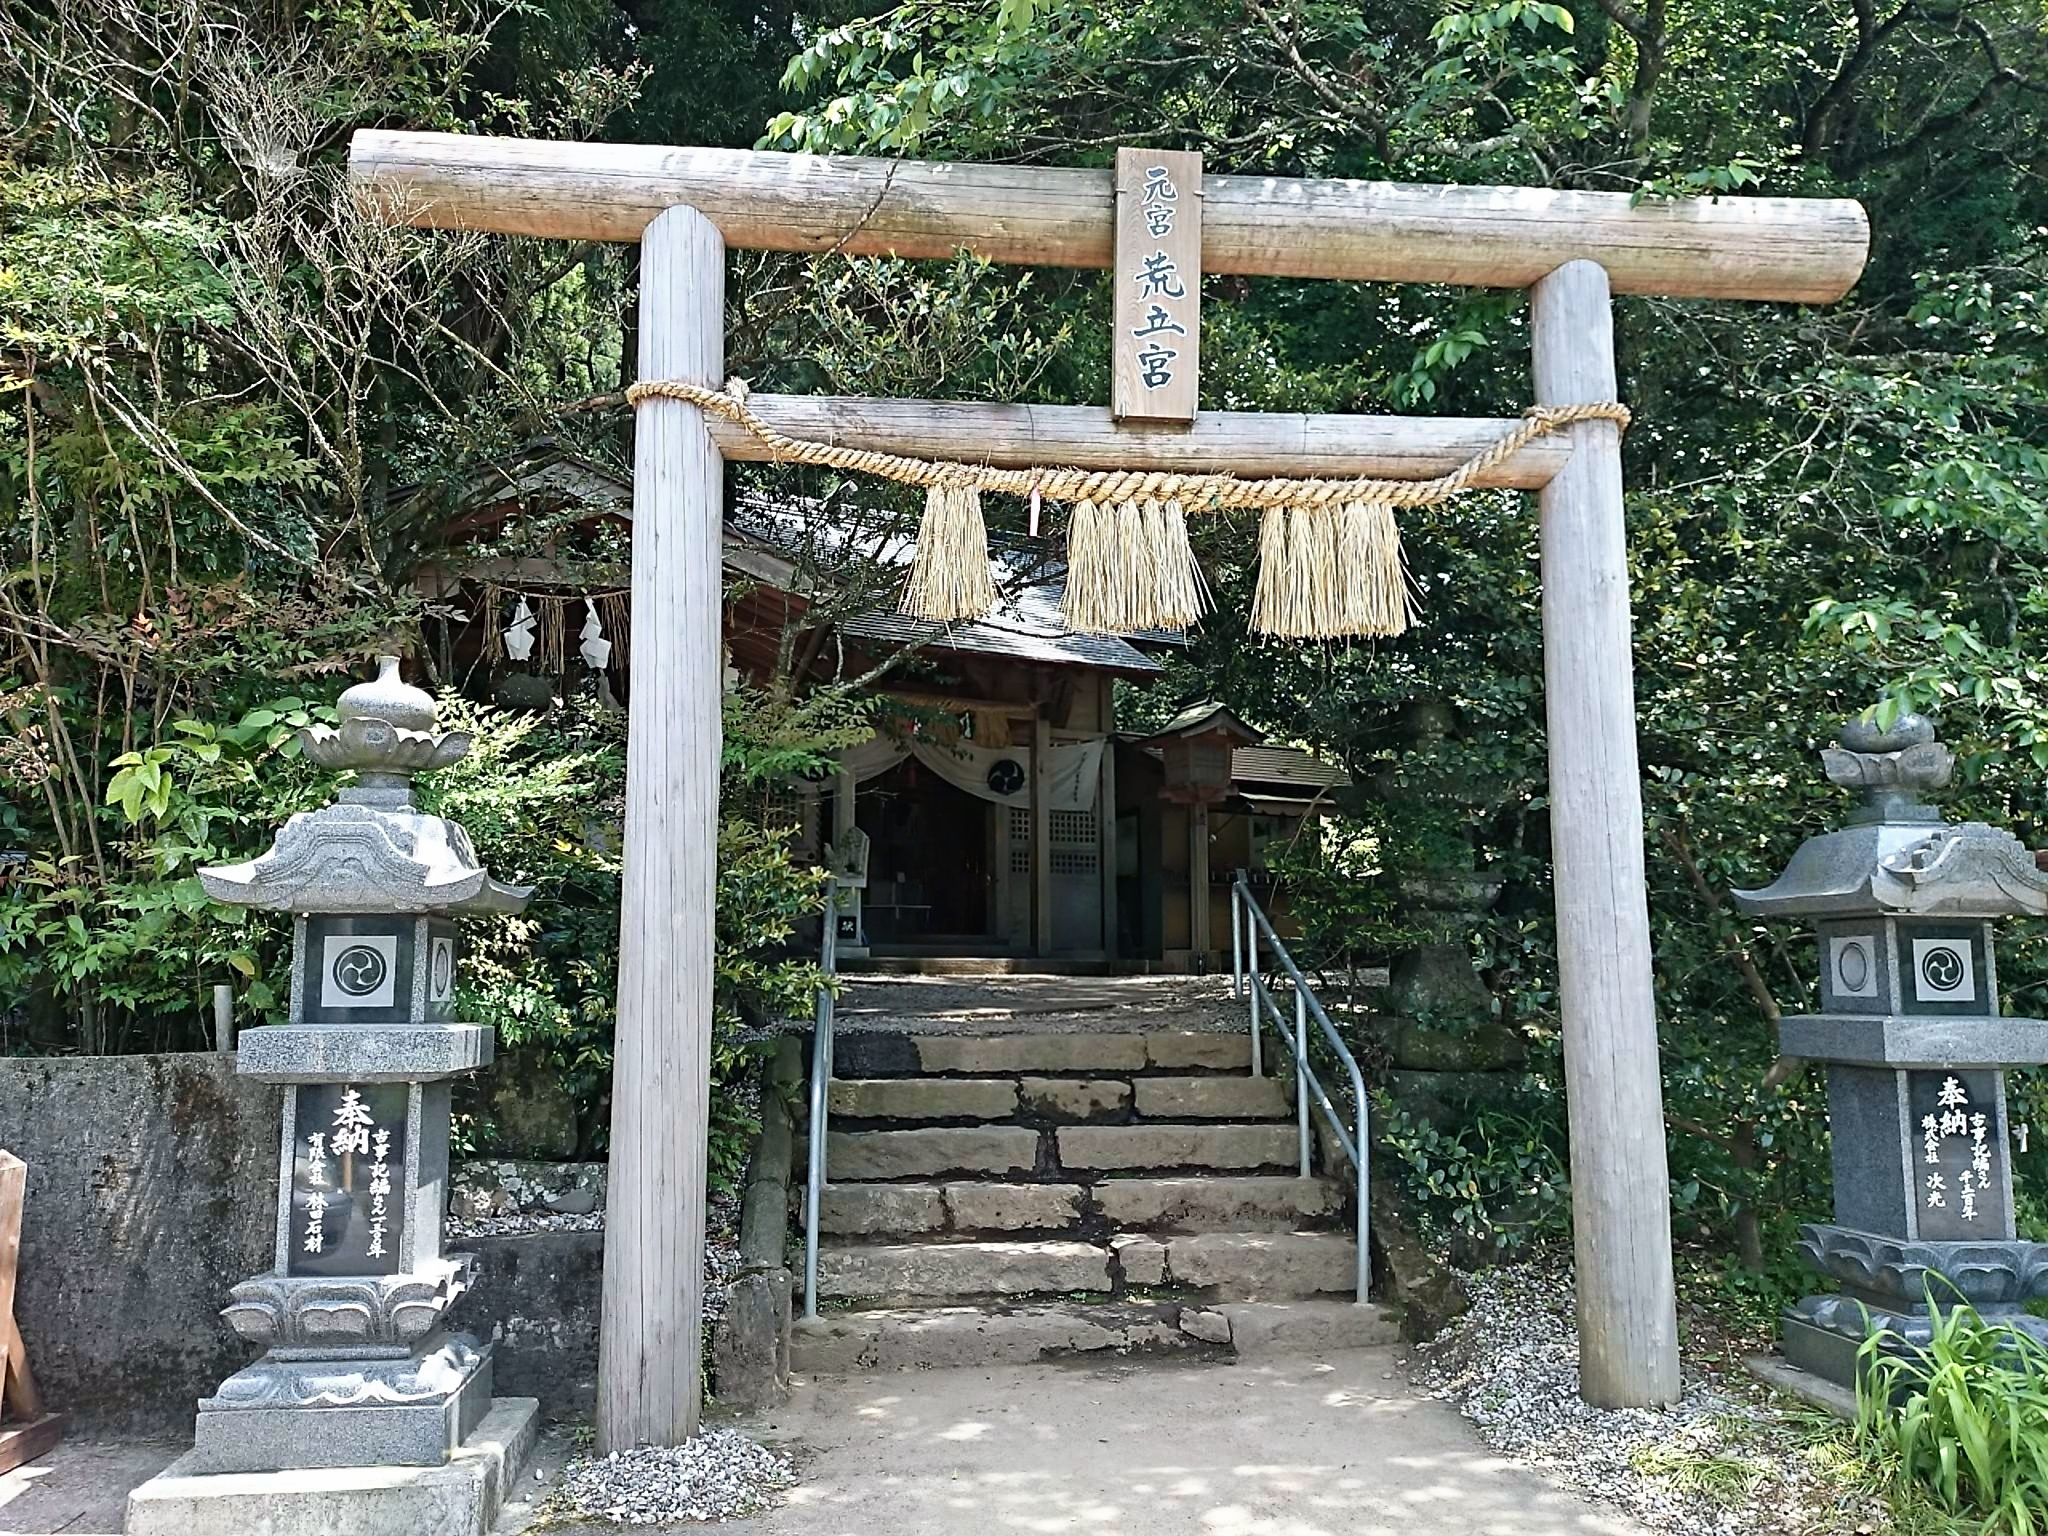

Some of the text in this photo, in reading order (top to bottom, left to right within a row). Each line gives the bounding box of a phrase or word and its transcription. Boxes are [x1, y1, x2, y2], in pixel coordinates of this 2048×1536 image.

[1132, 167, 1187, 389] 元宮 荒立宮
[330, 1090, 375, 1156] 奉納
[1937, 1076, 1968, 1138] 奉納
[304, 1132, 329, 1254] 有限会社 林田石材
[1921, 1113, 1947, 1208] 株式会社 次光
